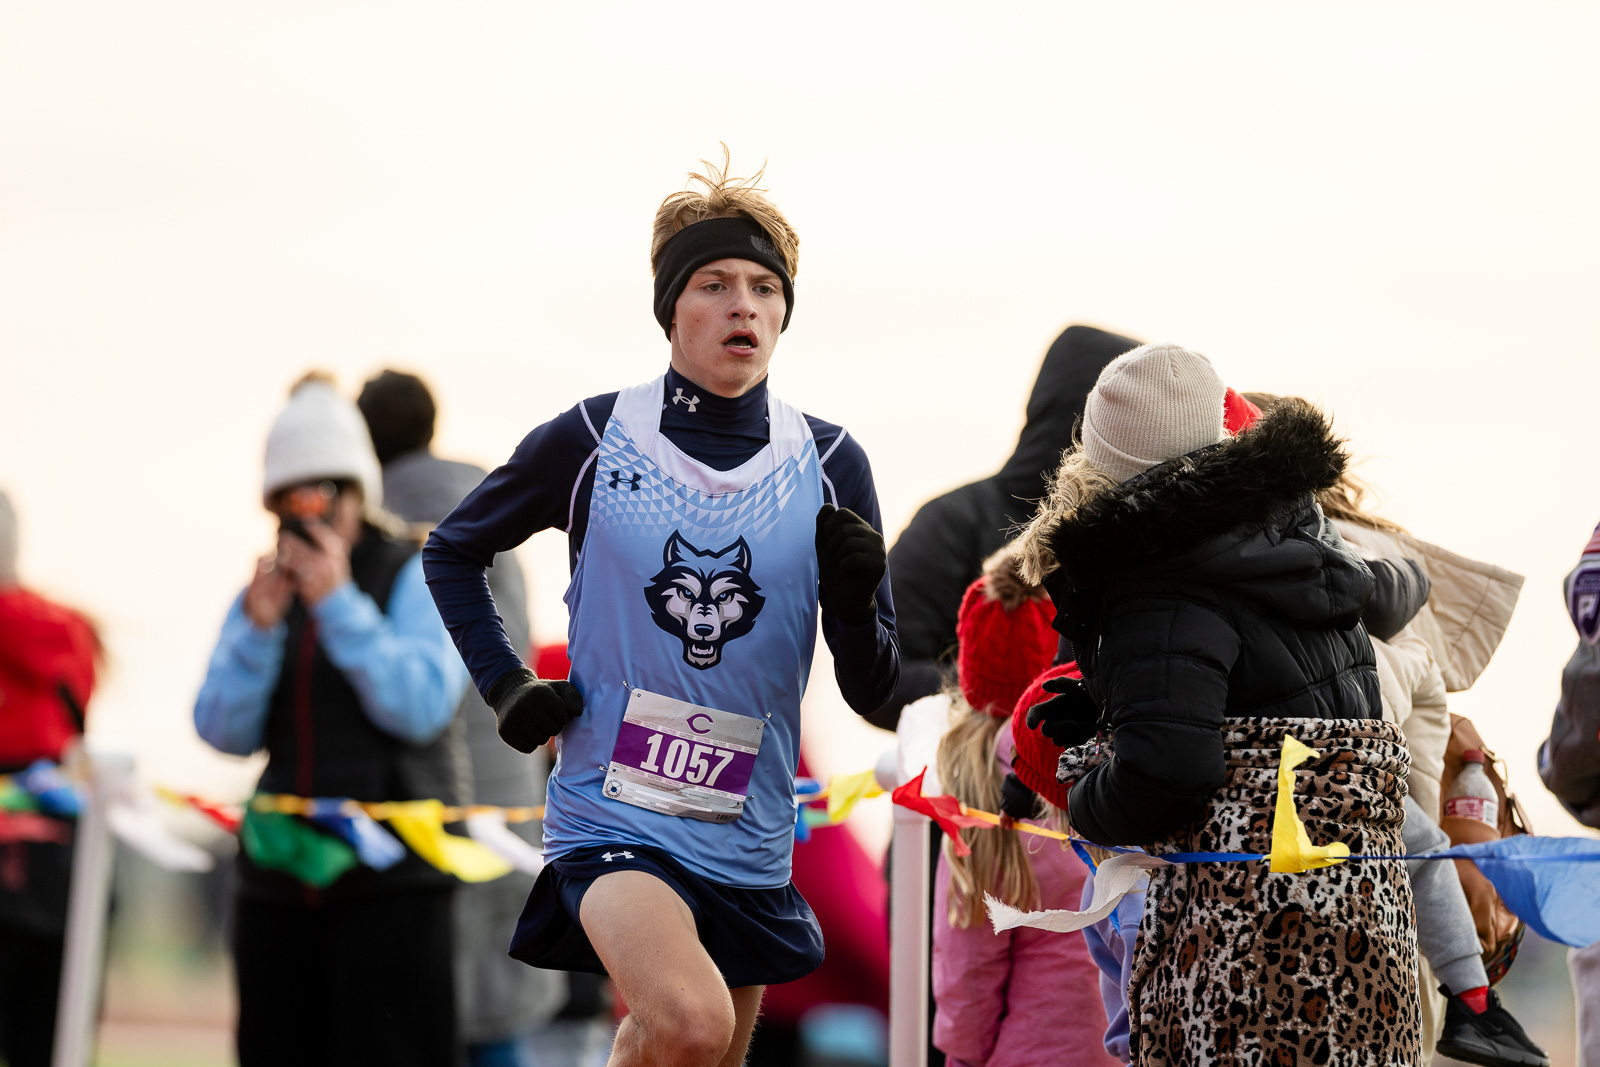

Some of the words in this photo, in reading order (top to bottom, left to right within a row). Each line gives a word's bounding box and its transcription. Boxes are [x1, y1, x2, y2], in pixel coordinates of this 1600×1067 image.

[686, 713, 714, 734] C
[640, 733, 735, 787] 1057
[715, 813, 733, 822] 1057
